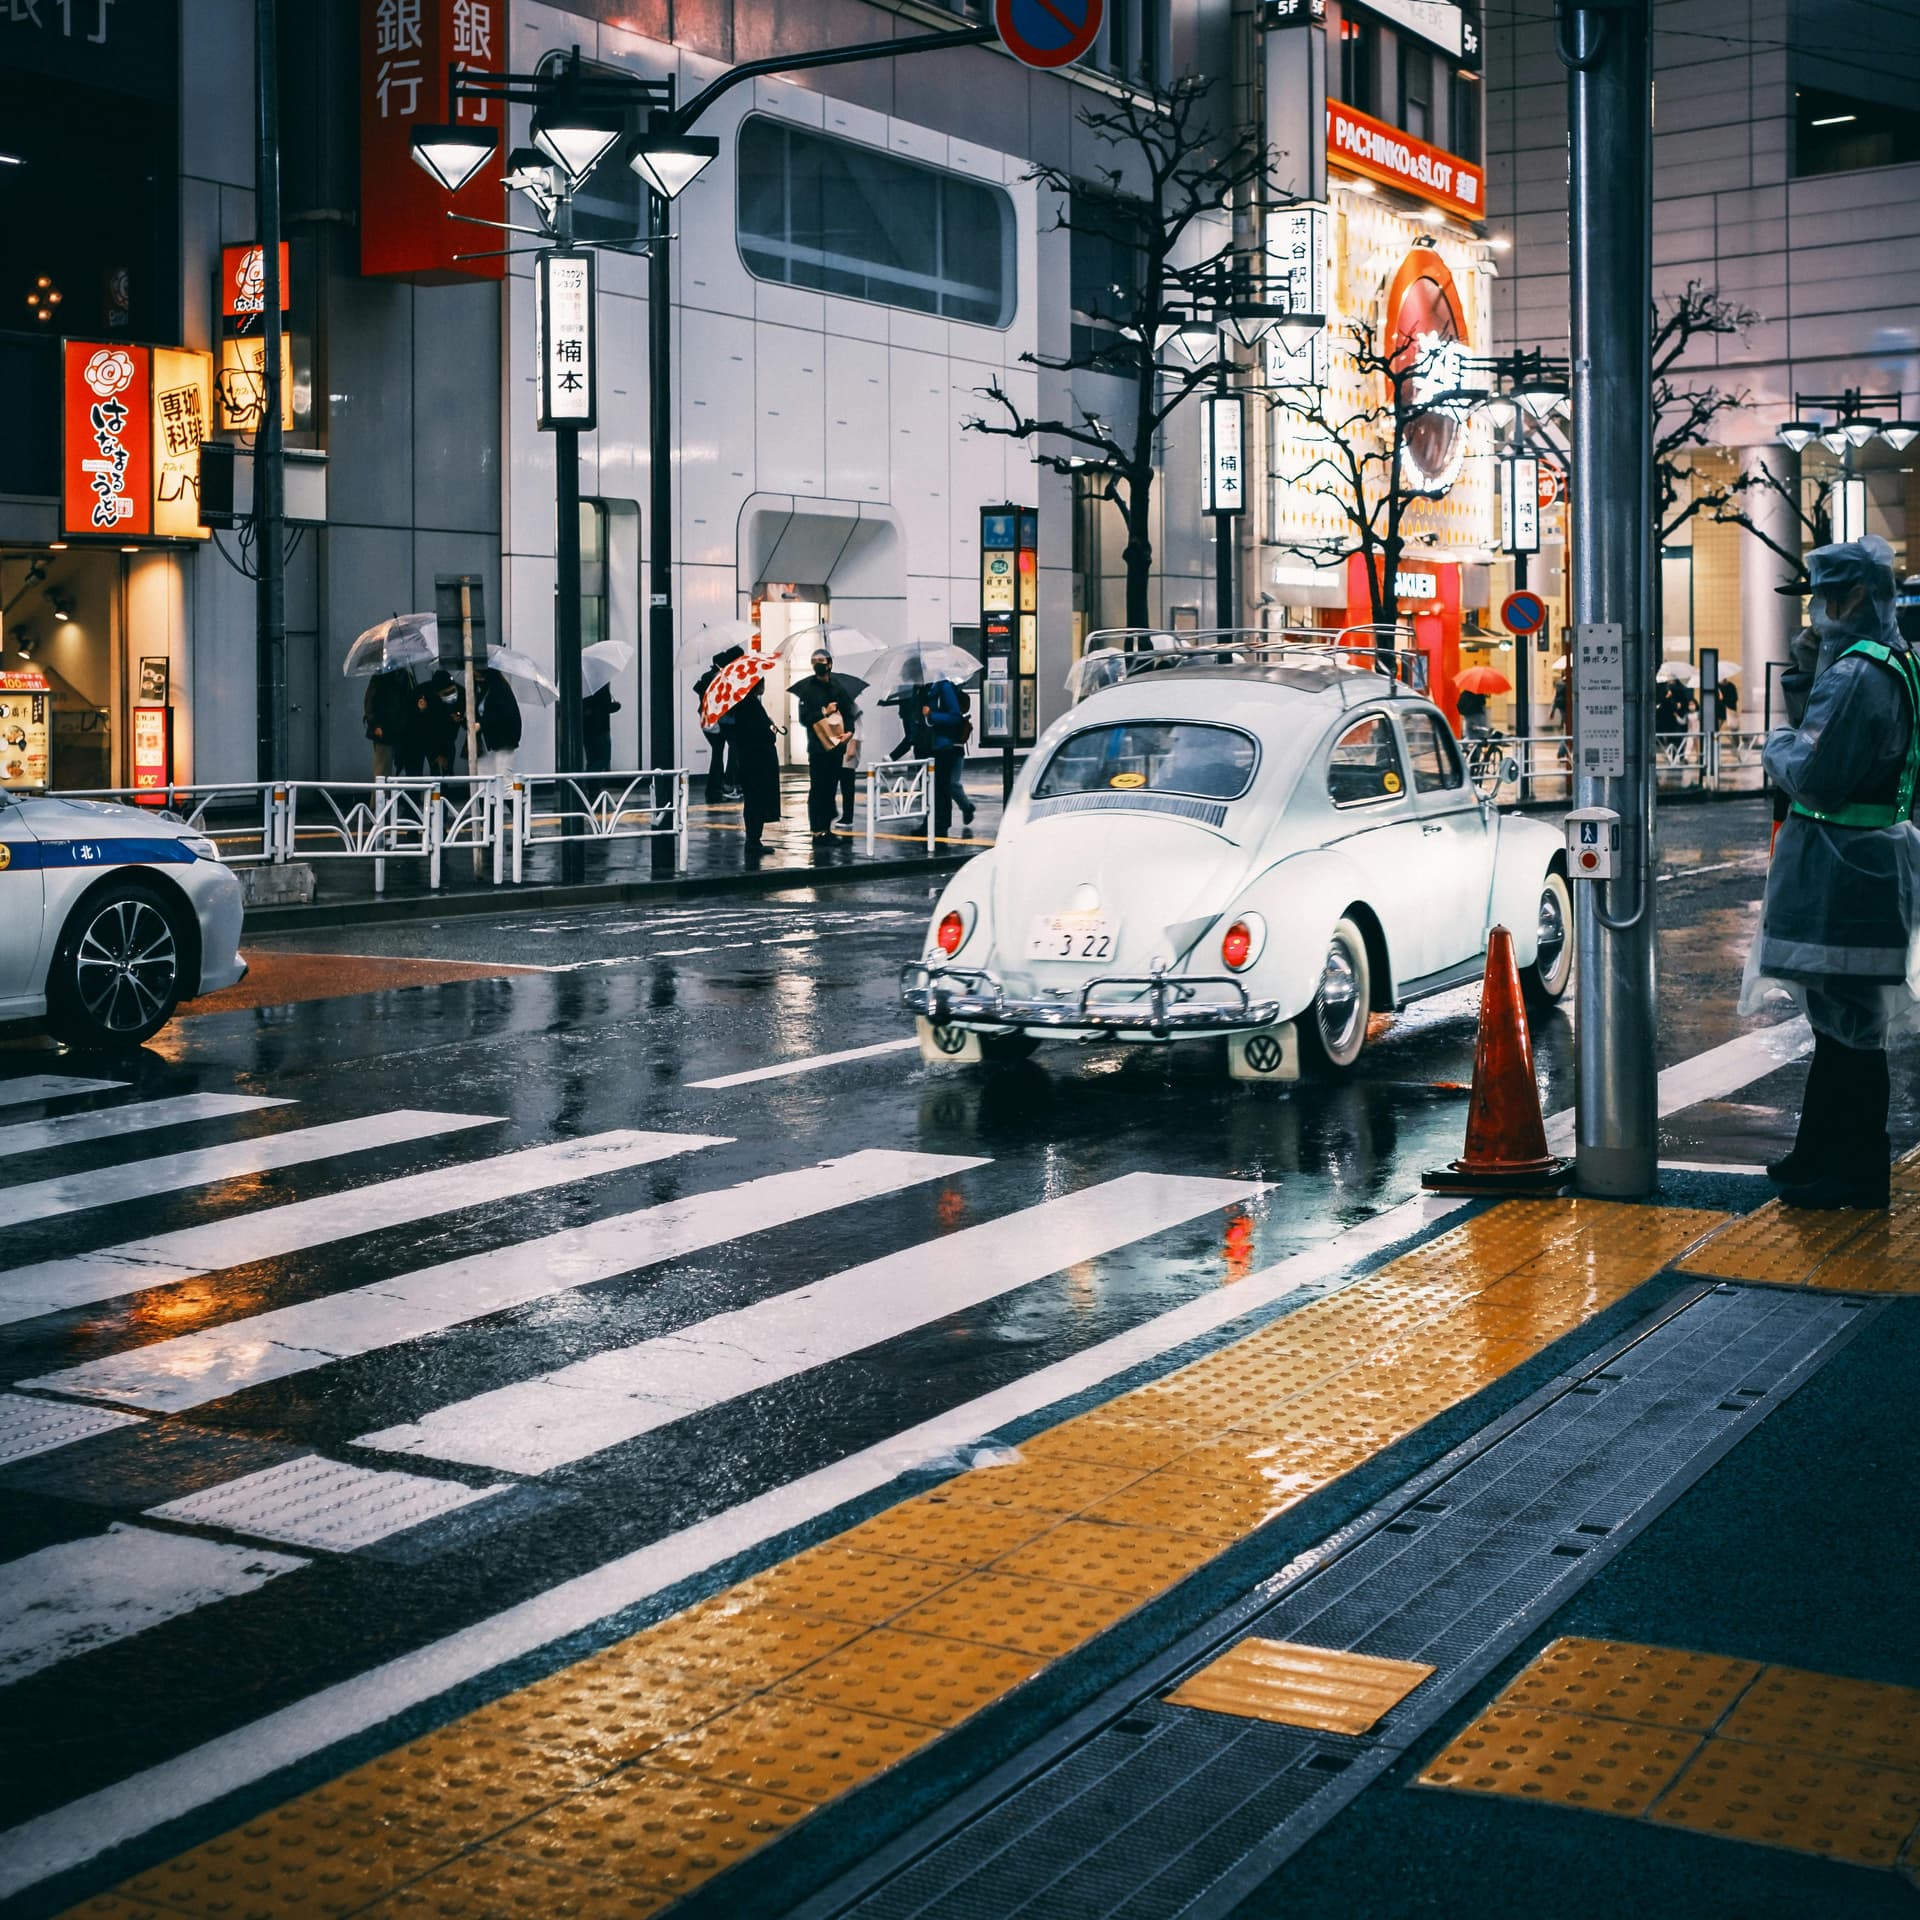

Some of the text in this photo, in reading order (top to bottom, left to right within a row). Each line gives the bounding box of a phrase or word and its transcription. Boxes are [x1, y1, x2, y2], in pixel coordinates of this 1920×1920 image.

[1277, 0, 1299, 15] 5F
[1463, 23, 1479, 54] 5F
[376, 0, 424, 118] 銀行
[1335, 116, 1453, 193] PACHINKO&SLOT
[555, 339, 584, 394] 楠本
[92, 398, 129, 526] はなまるうどん
